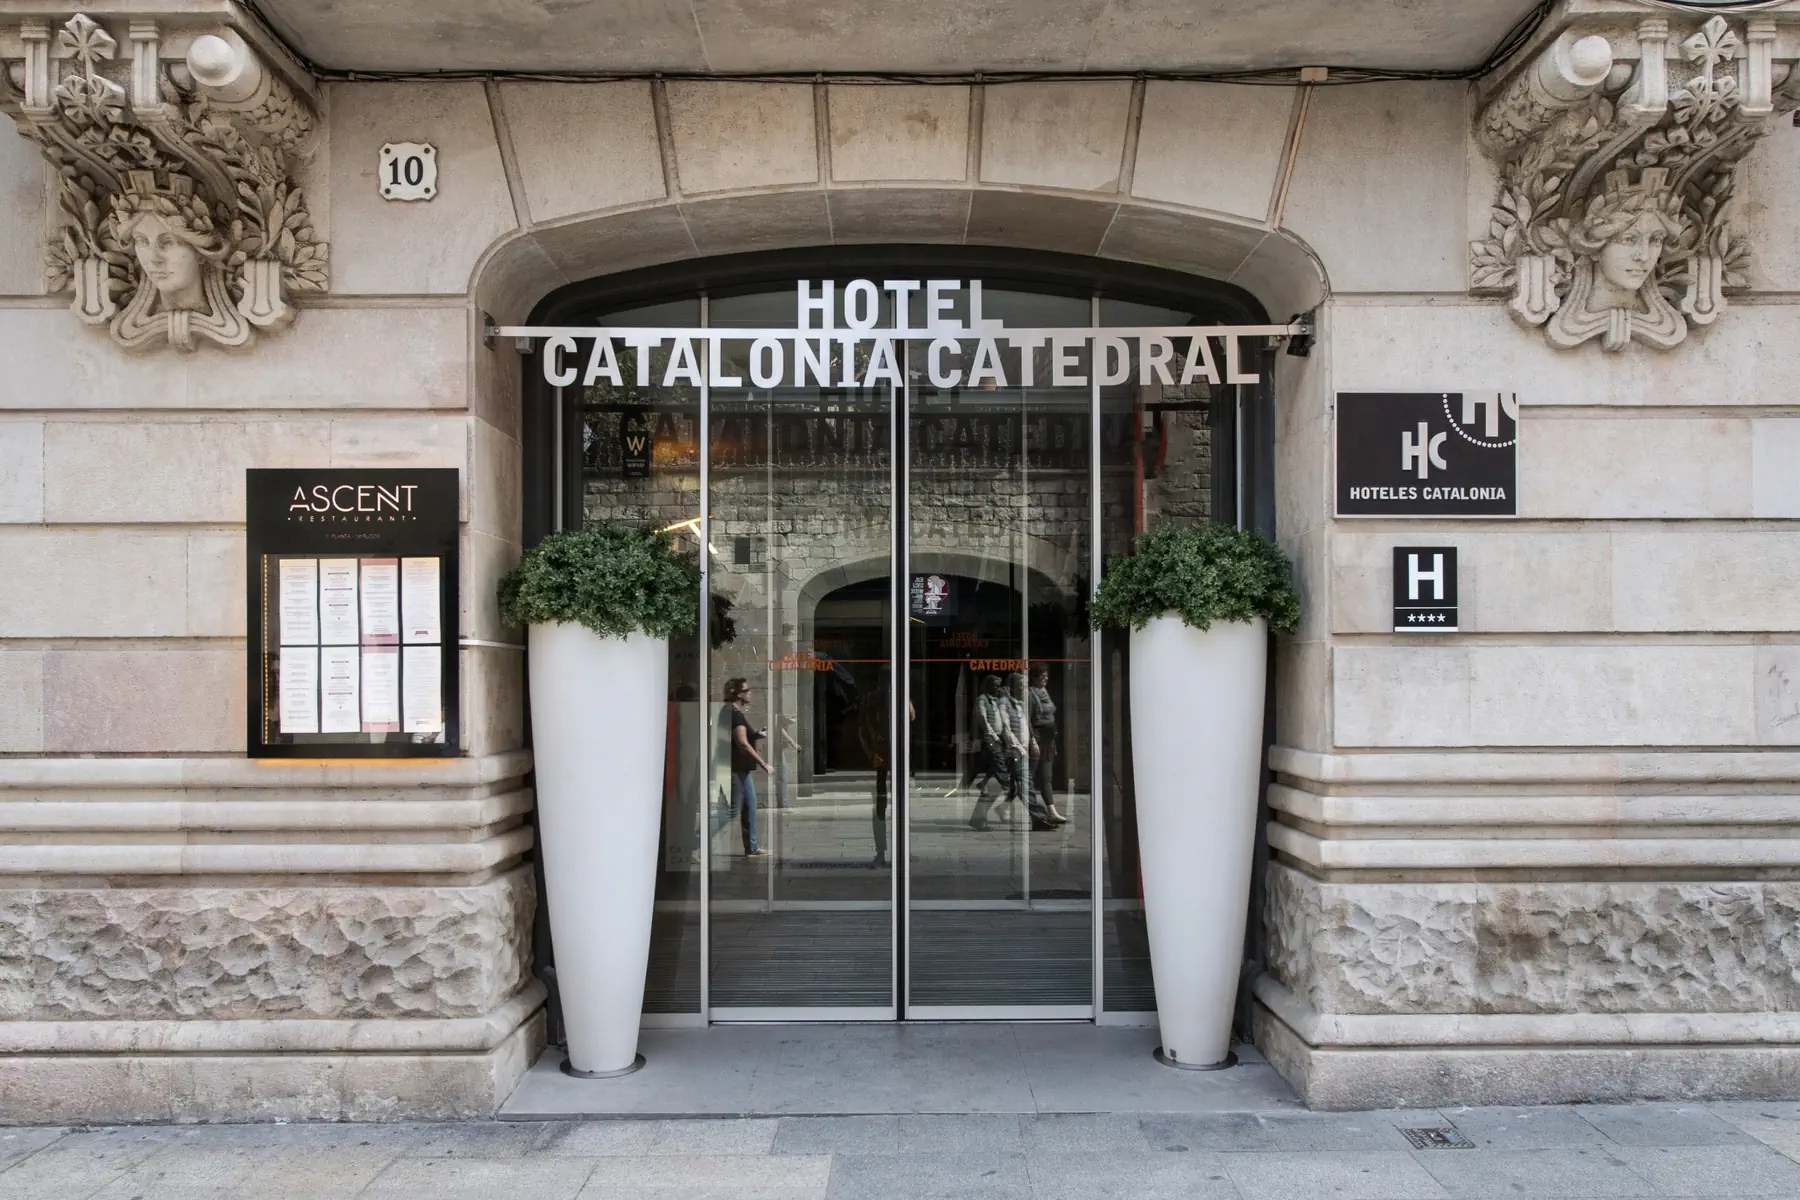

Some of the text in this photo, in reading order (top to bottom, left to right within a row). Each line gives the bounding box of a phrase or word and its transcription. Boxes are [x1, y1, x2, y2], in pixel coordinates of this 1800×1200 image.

[389, 156, 423, 186] 10
[797, 279, 1003, 331] HOTEL
[543, 335, 1260, 389] CATALONIA CATEDRAL
[290, 485, 418, 512] ASCENT
[1350, 487, 1506, 500] HOTELES CATALONIA
[299, 515, 405, 523] RESTAURANT
[1408, 553, 1444, 600] H
[969, 659, 1030, 671] CATEDRAL
